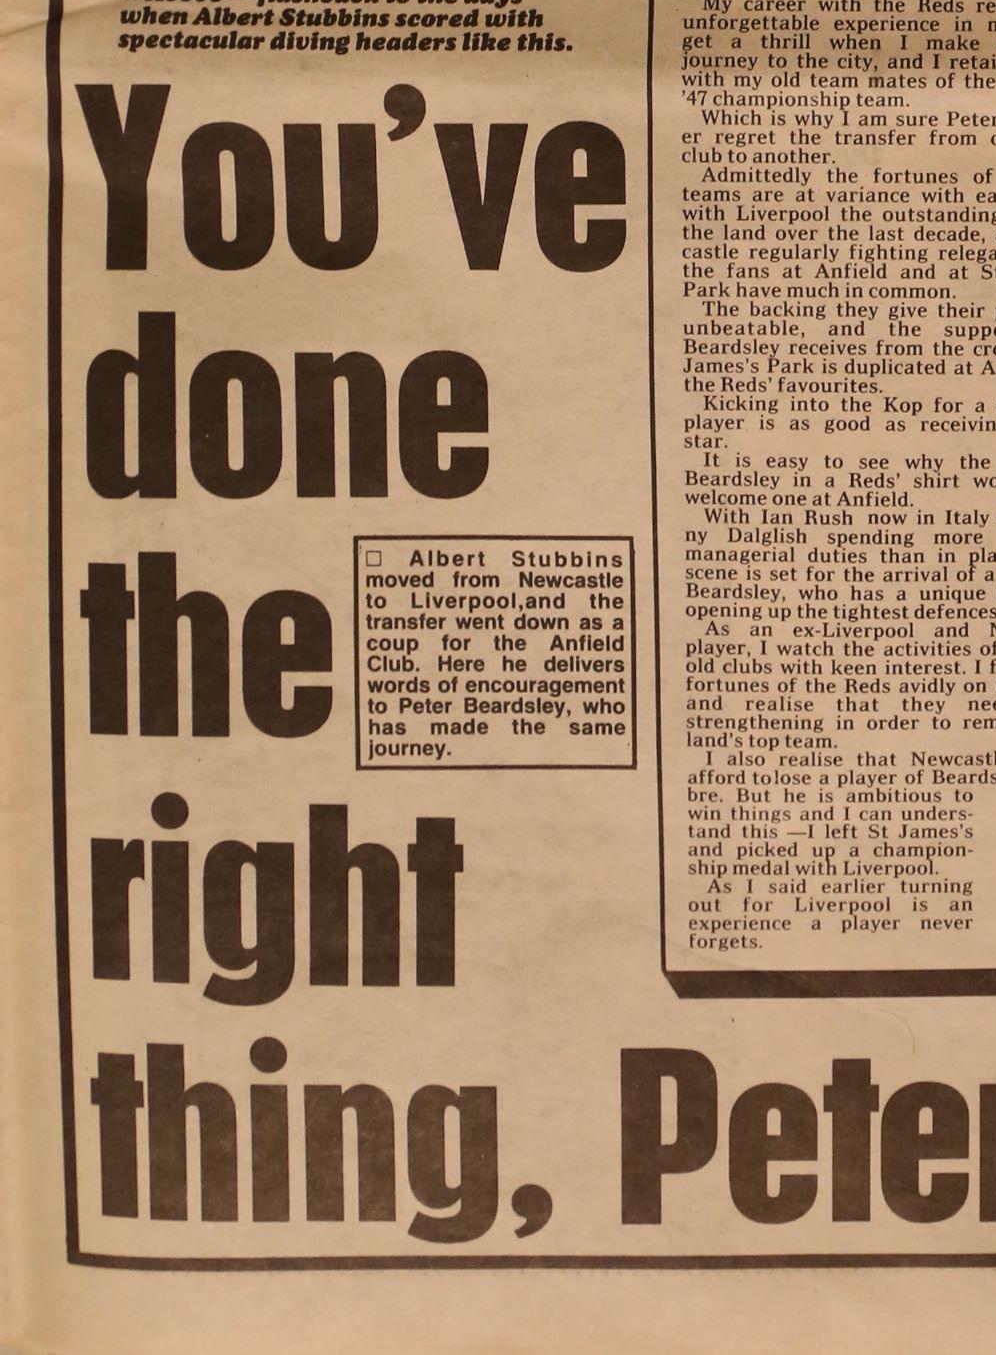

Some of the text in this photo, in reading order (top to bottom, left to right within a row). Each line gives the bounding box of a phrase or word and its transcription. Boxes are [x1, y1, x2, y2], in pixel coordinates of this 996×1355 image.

[119, 5, 544, 29] when Albert Stubbins scored with
[743, 0, 807, 13] career
[117, 29, 574, 55] spectacular diving headers like this.
[681, 70, 725, 87] with
[734, 75, 762, 91] my
[771, 71, 801, 88] old
[809, 73, 859, 89] team
[868, 73, 927, 89] mates
[935, 71, 956, 89] of
[964, 72, 996, 90] the
[681, 89, 910, 110] '47 championship team.
[74, 83, 627, 273] You've
[85, 310, 490, 500] done
[703, 394, 779, 415] Kicking
[790, 395, 830, 412] into
[840, 395, 872, 413] the
[883, 396, 923, 417] Kop
[933, 396, 964, 414] for
[974, 401, 985, 413] a
[409, 549, 623, 569] Albert Stubbins
[365, 570, 624, 589] moved from Newcastle
[365, 592, 387, 610] to
[589, 592, 624, 610] the
[365, 612, 624, 631] transfer went down as a
[79, 551, 333, 739] the
[366, 633, 625, 656] coup for the Anfield
[366, 654, 625, 673] Club. Here he delivers
[367, 675, 626, 698] words of encouragement
[367, 696, 626, 719] to Peter Beardsley, who
[368, 717, 626, 736] has made the same
[368, 739, 452, 761] journey.
[90, 792, 464, 1007] right
[688, 914, 974, 934] experience a player never
[689, 931, 764, 951] forgets.
[90, 1035, 553, 1244] thing,
